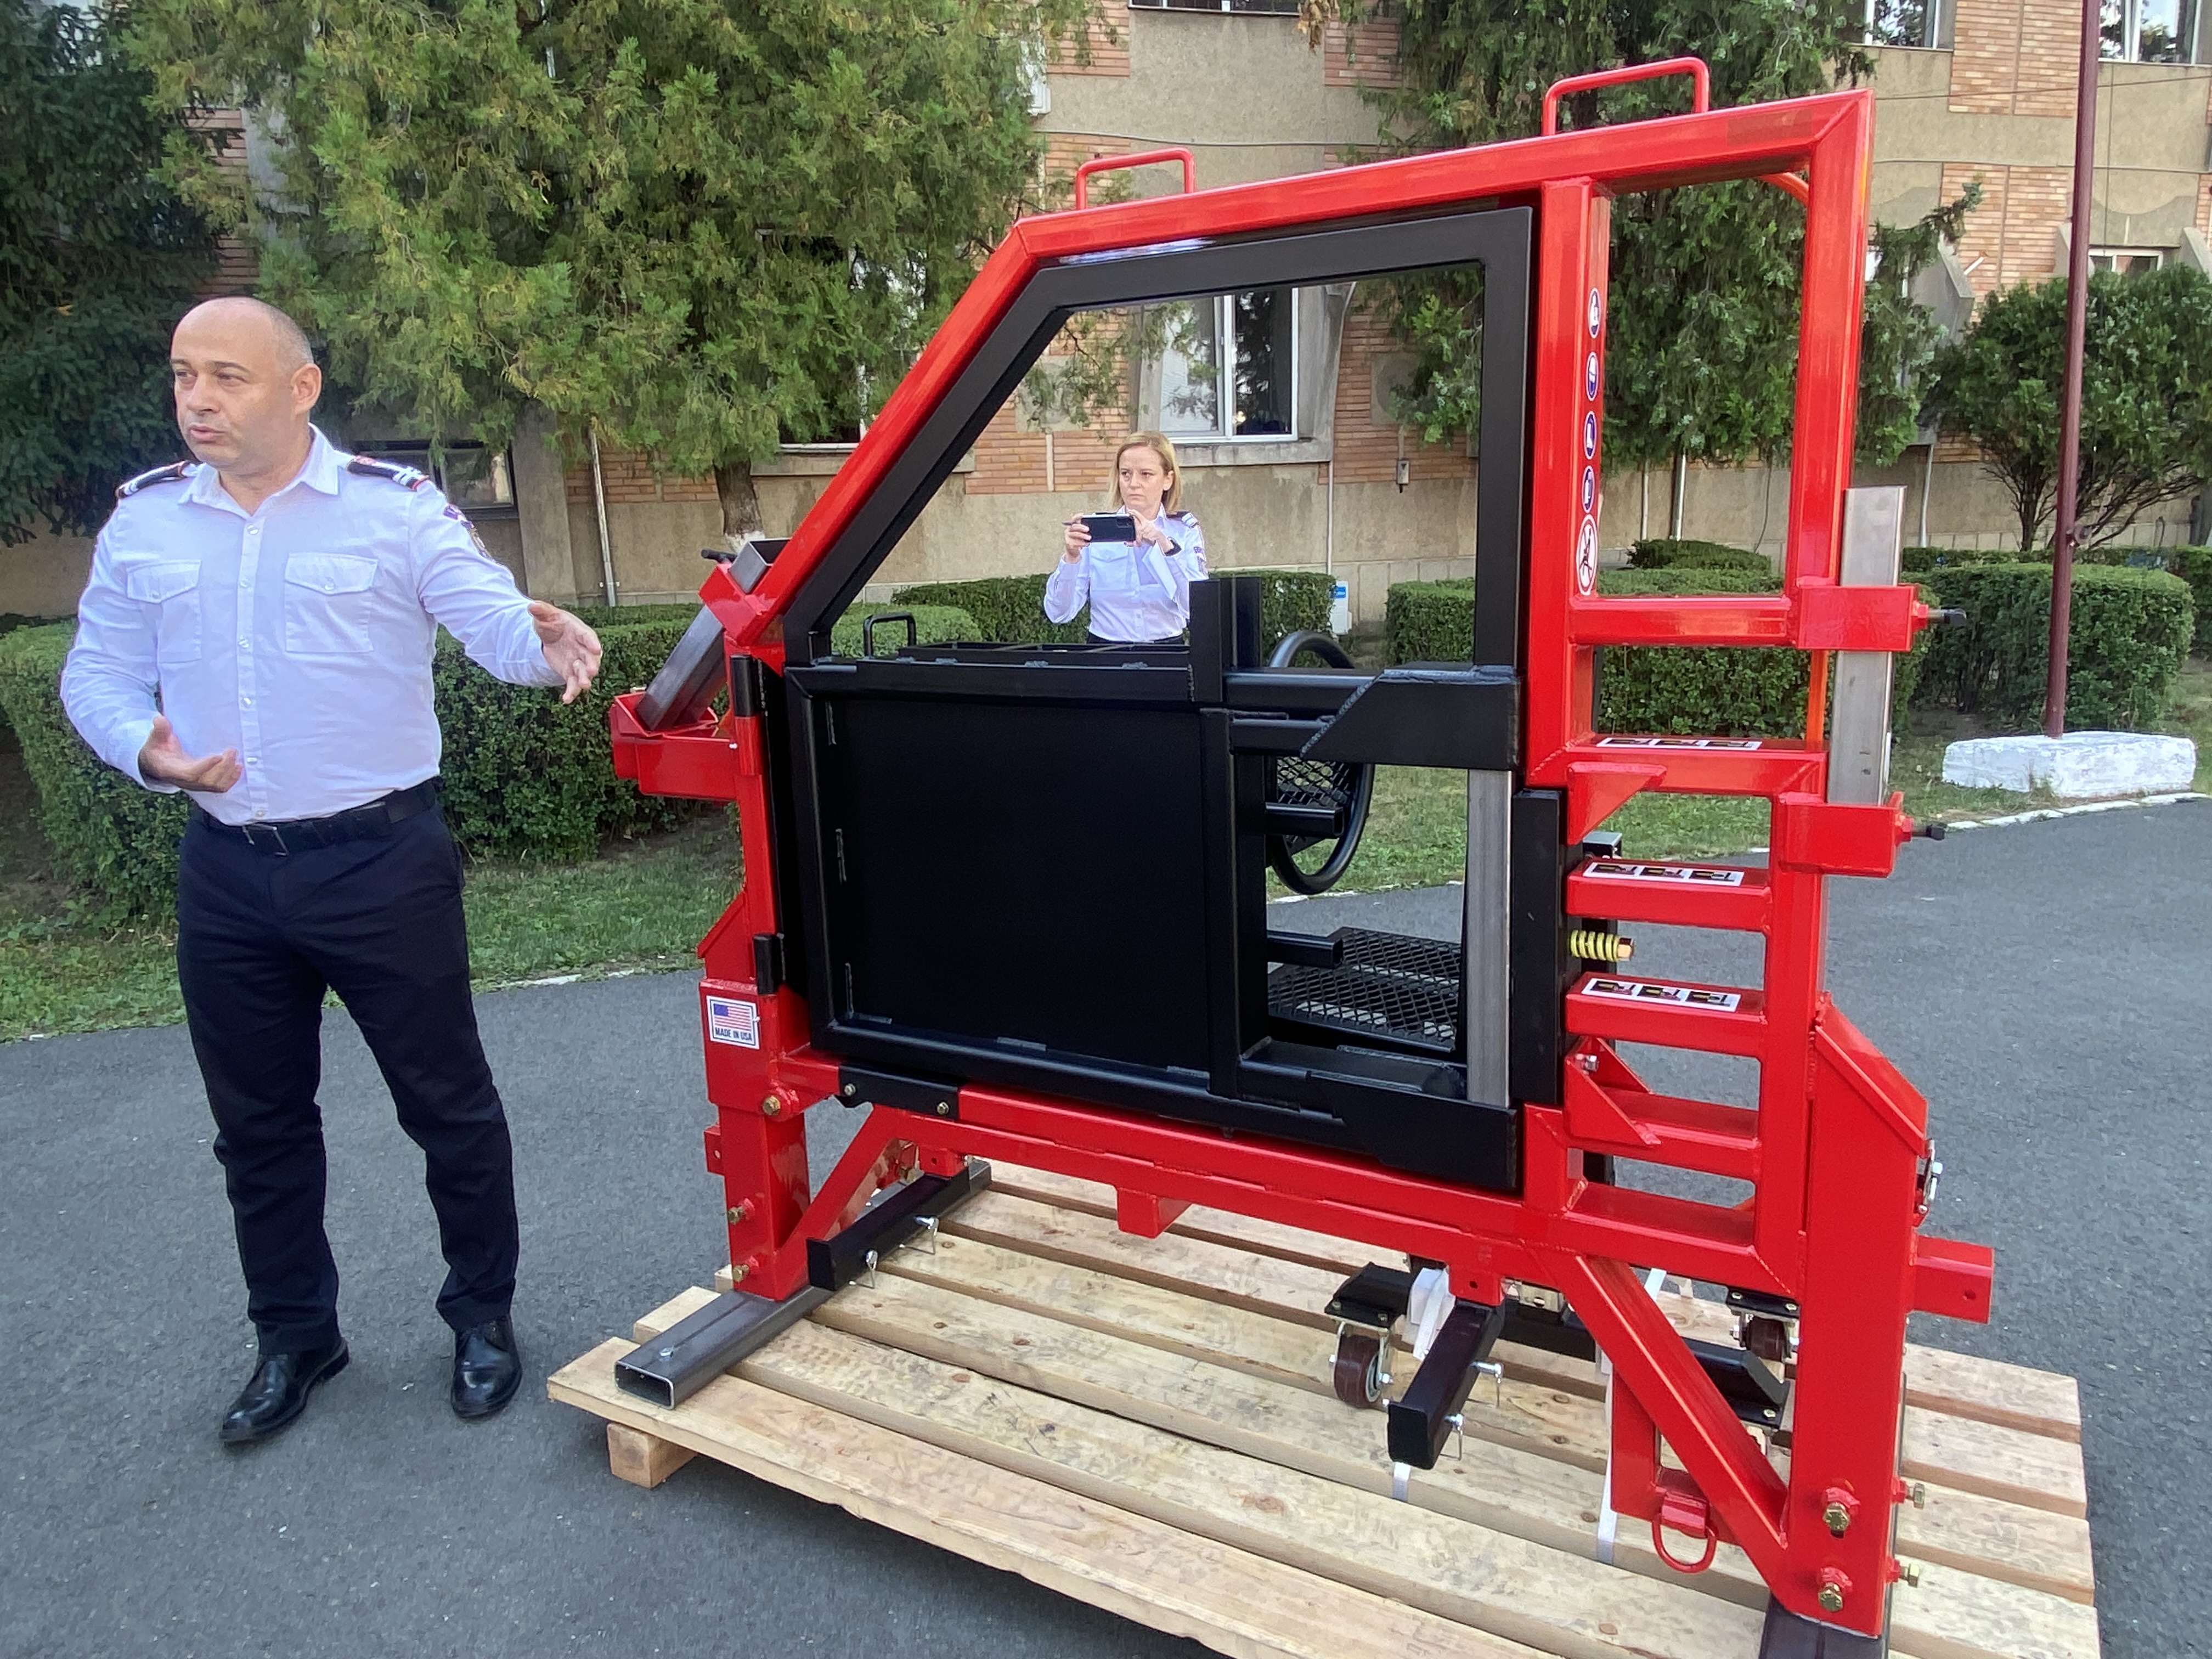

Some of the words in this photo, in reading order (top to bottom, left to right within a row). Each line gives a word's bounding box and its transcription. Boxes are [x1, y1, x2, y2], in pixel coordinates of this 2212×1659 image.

[715, 1027, 731, 1037] MADE
[733, 1030, 740, 1039] IN
[740, 1031, 752, 1041] USA
